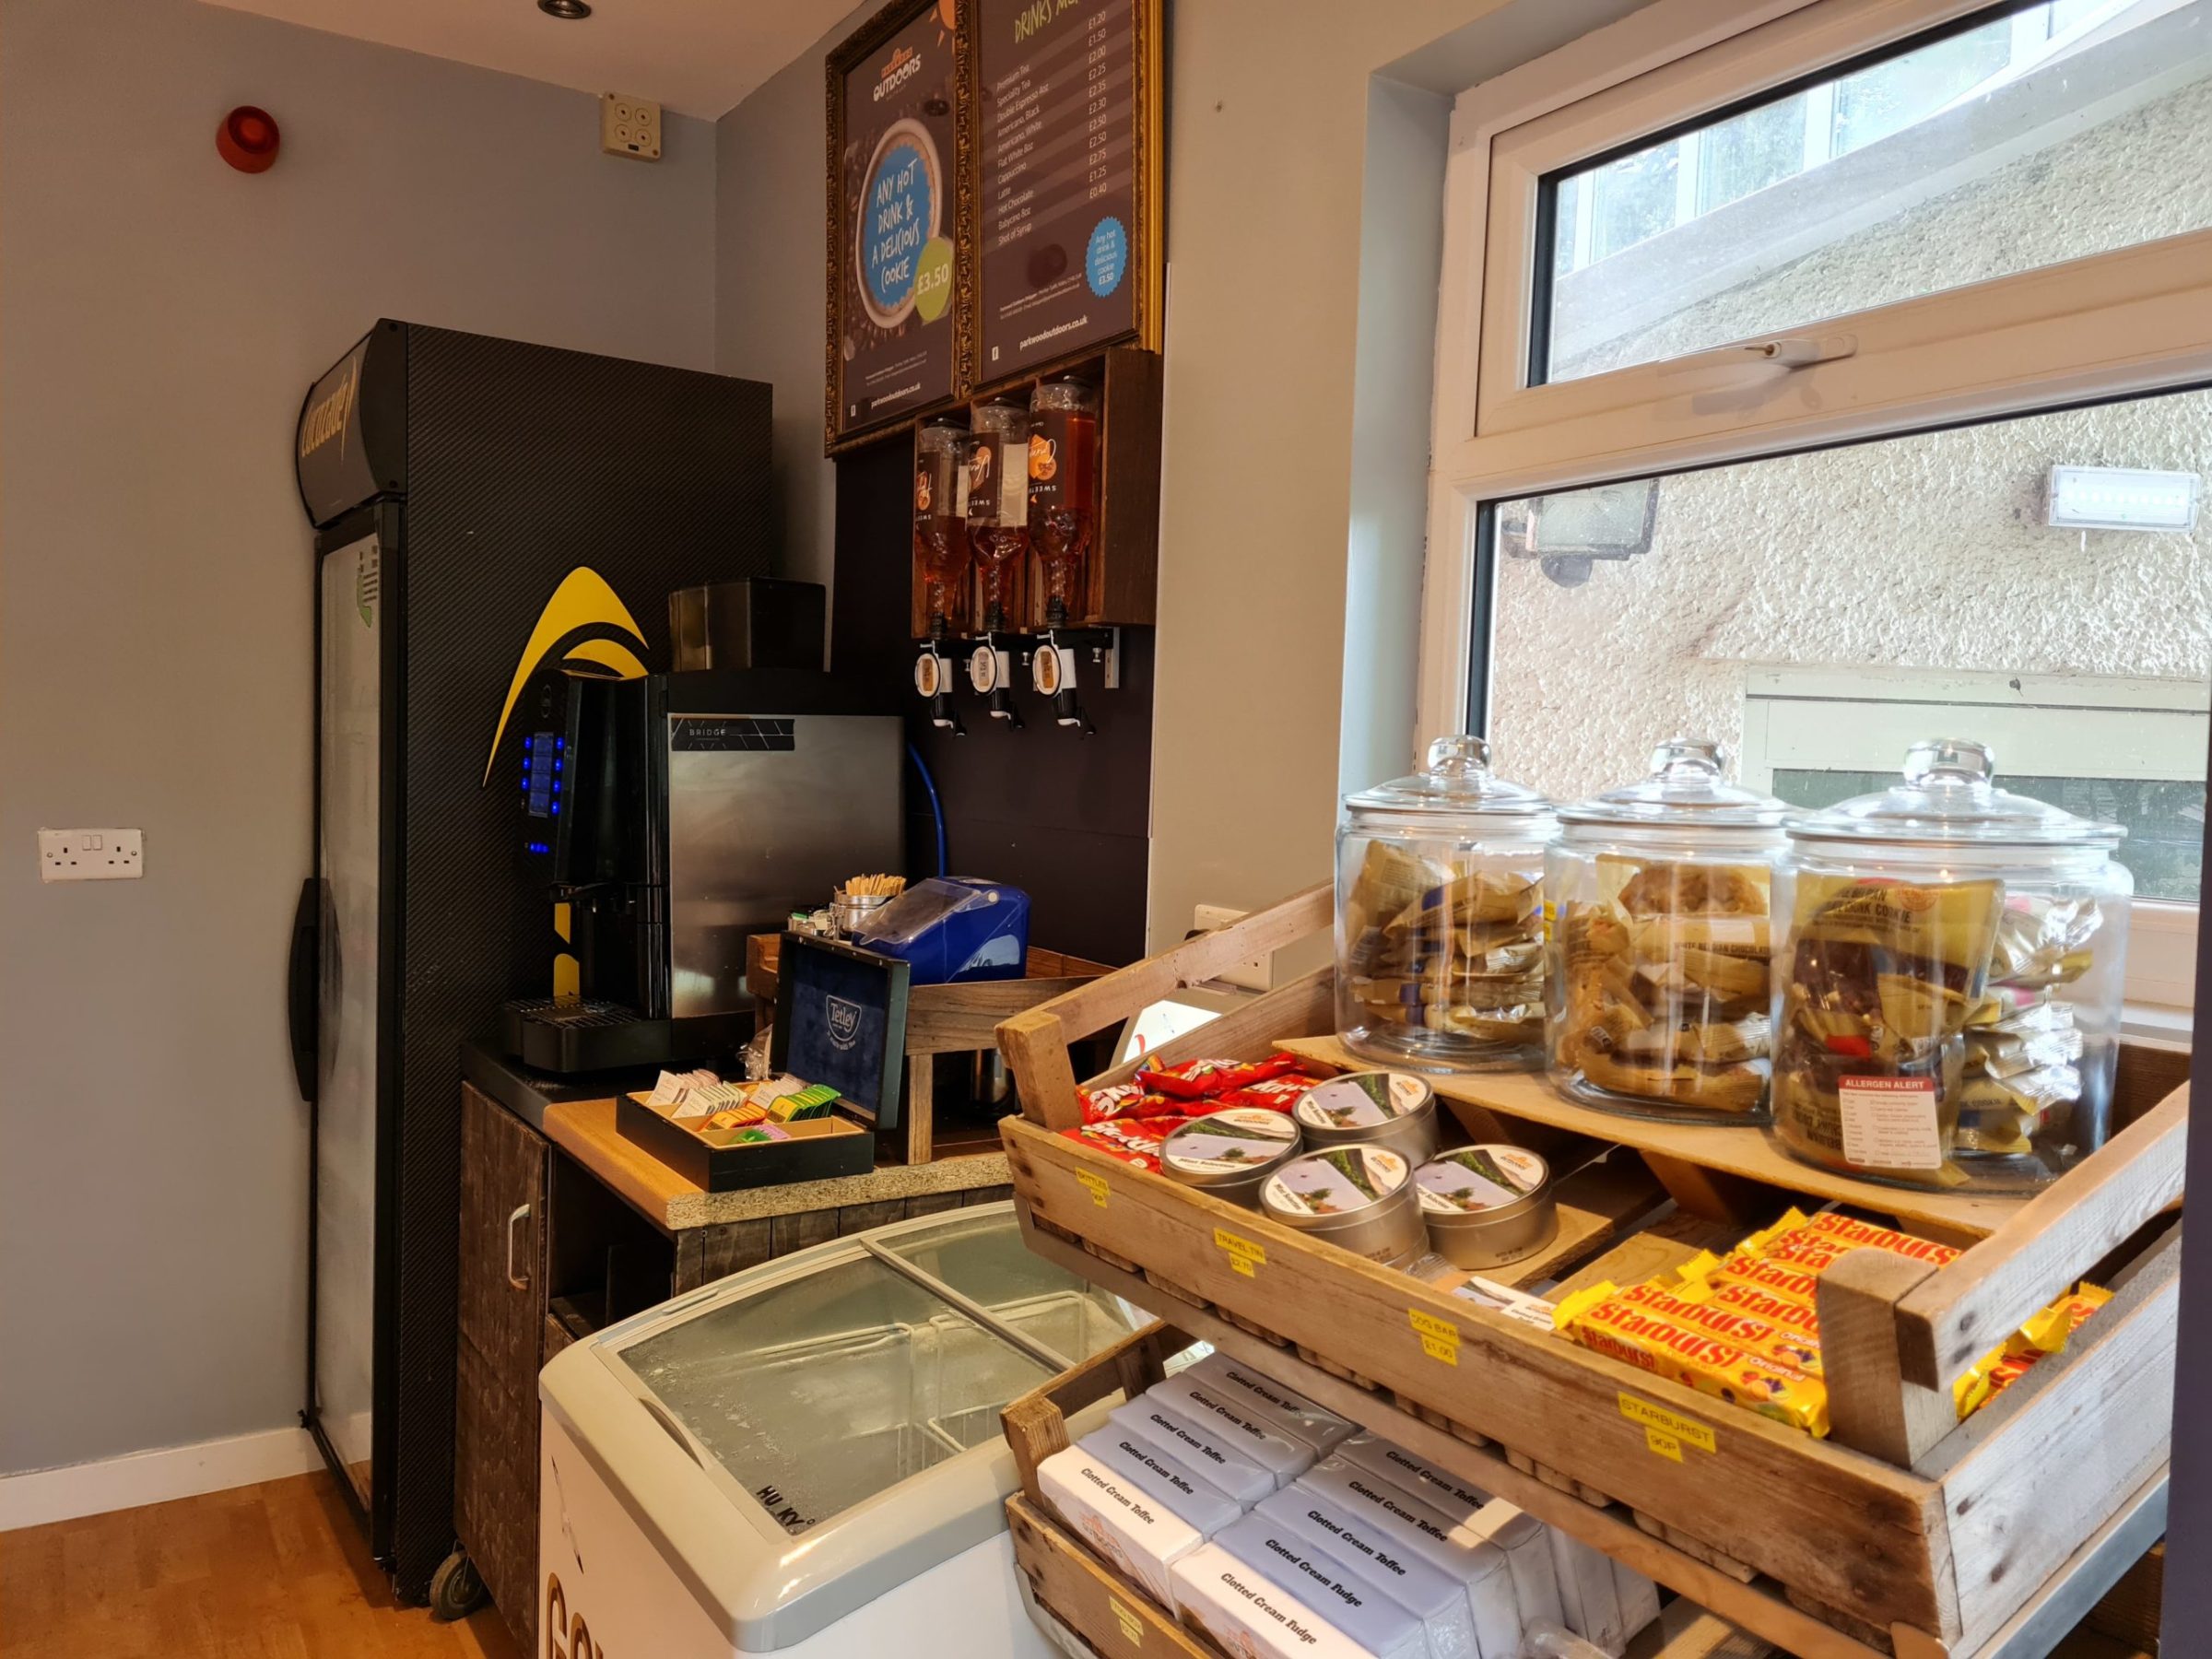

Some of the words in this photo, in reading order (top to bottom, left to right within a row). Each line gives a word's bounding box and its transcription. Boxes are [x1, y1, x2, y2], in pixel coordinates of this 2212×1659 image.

[1014, 0, 1052, 43] DRINKS
[1088, 10, 1106, 30] £1.20
[1088, 29, 1106, 47] £1.50
[1088, 45, 1106, 64] £2.00
[873, 53, 921, 101] OUTDOORS
[996, 71, 1019, 92] Premium
[1019, 65, 1030, 75] Tea
[1088, 63, 1106, 81] £2.25
[997, 87, 1020, 108] Speciality
[1021, 79, 1030, 90] Tea
[1088, 79, 1106, 98] £2.35
[997, 105, 1015, 123] Double
[1016, 91, 1038, 111] Espresso
[1026, 104, 1040, 120] Black
[1088, 97, 1106, 115] £2.30
[1026, 121, 1041, 136] White
[1088, 113, 1106, 132] £2.50
[1089, 131, 1107, 148] £2.50
[998, 156, 1007, 168] Flat
[1008, 147, 1023, 162] White
[1089, 148, 1107, 165] £2.75
[877, 174, 894, 208] ANY
[897, 158, 918, 194] HOT
[998, 162, 1027, 184] Cappuccino
[1089, 165, 1107, 182] £1.25
[998, 187, 1011, 200] Latte
[998, 204, 1007, 214] Hot
[1007, 190, 1034, 207] Chocolate
[1089, 182, 1107, 199] £0.40
[878, 201, 903, 234] DRINK
[906, 194, 913, 220] &
[998, 213, 1020, 230] Babycino
[872, 245, 878, 269] A
[881, 218, 920, 262] DELICIOUS
[998, 235, 1010, 247] Shot
[1010, 230, 1017, 240] of
[1017, 223, 1031, 237] Syrup
[1096, 235, 1106, 245] Any
[1107, 229, 1115, 240] hot
[881, 256, 910, 293] COOKIE
[917, 264, 949, 294] £3.50
[1019, 314, 1088, 351] parkwoodoutdoors.co.uk
[688, 728, 726, 736] BRIDGE
[830, 1002, 858, 1033] Tetley
[1845, 1079, 1891, 1088] ALLERGEN
[1893, 1081, 1924, 1089] ALERT
[1218, 1231, 1247, 1252] TRAVEL
[1249, 1244, 1265, 1258] TIN
[1623, 1284, 1776, 1343] Starburst
[1434, 1322, 1458, 1337] BAR
[1590, 1301, 1744, 1369] Starburst
[1425, 1339, 1453, 1359] £1.00
[1581, 1324, 1655, 1370] Starburst
[1226, 1371, 1255, 1394] Clotted
[1253, 1383, 1279, 1406] Cream
[1189, 1391, 1218, 1413] Clotted
[1215, 1405, 1241, 1425] Cream
[1241, 1419, 1266, 1441] Toffee
[1620, 1397, 1712, 1442] STARBURST
[1150, 1413, 1177, 1436] Clotted
[1175, 1428, 1201, 1450] Cream
[1199, 1443, 1227, 1465] Toffee
[1119, 1441, 1146, 1464] Clotted
[1144, 1456, 1171, 1479] Cream
[1168, 1475, 1194, 1496] Toffee
[1386, 1451, 1422, 1473] Clotted
[1420, 1469, 1453, 1492] Cream
[1453, 1488, 1485, 1510] Toffee
[1081, 1467, 1109, 1489] Clotted
[1106, 1484, 1132, 1507] Cream
[1130, 1502, 1155, 1524] Toffee
[1347, 1480, 1383, 1505] Clotted
[1382, 1500, 1417, 1523] Cream
[1417, 1520, 1448, 1542] Toffee
[1307, 1510, 1342, 1535] Clotted
[1340, 1531, 1374, 1557] Cream
[1373, 1552, 1406, 1577] Toffee
[1265, 1539, 1300, 1565] Clotted
[1298, 1559, 1332, 1588] Cream
[1332, 1583, 1363, 1609] Fudge
[1220, 1572, 1255, 1600] Clotted
[1253, 1594, 1287, 1622] Cream
[1286, 1620, 1317, 1646] Fudge
